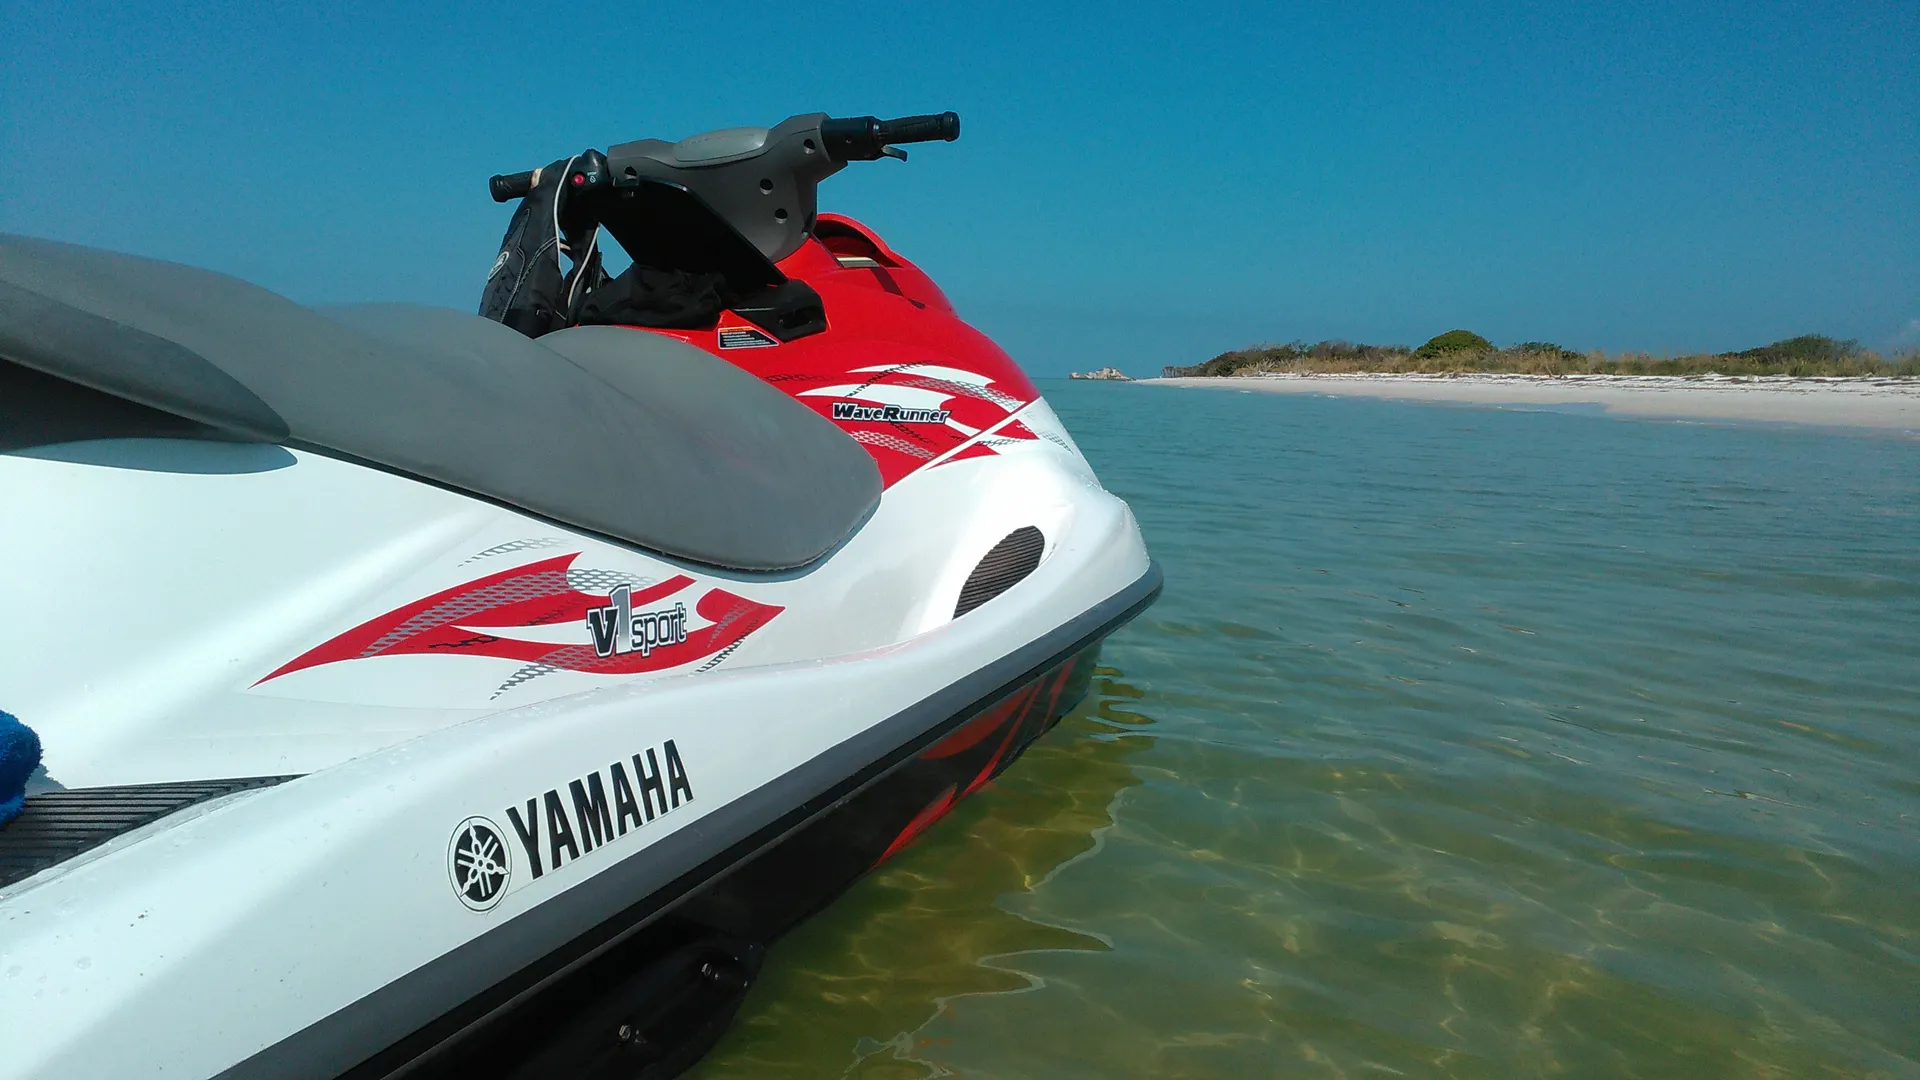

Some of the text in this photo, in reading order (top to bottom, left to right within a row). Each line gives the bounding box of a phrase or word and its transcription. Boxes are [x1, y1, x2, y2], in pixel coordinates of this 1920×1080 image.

[833, 403, 950, 423] WaveRunner
[631, 603, 686, 656] sport
[505, 738, 694, 880] YAMAHA
